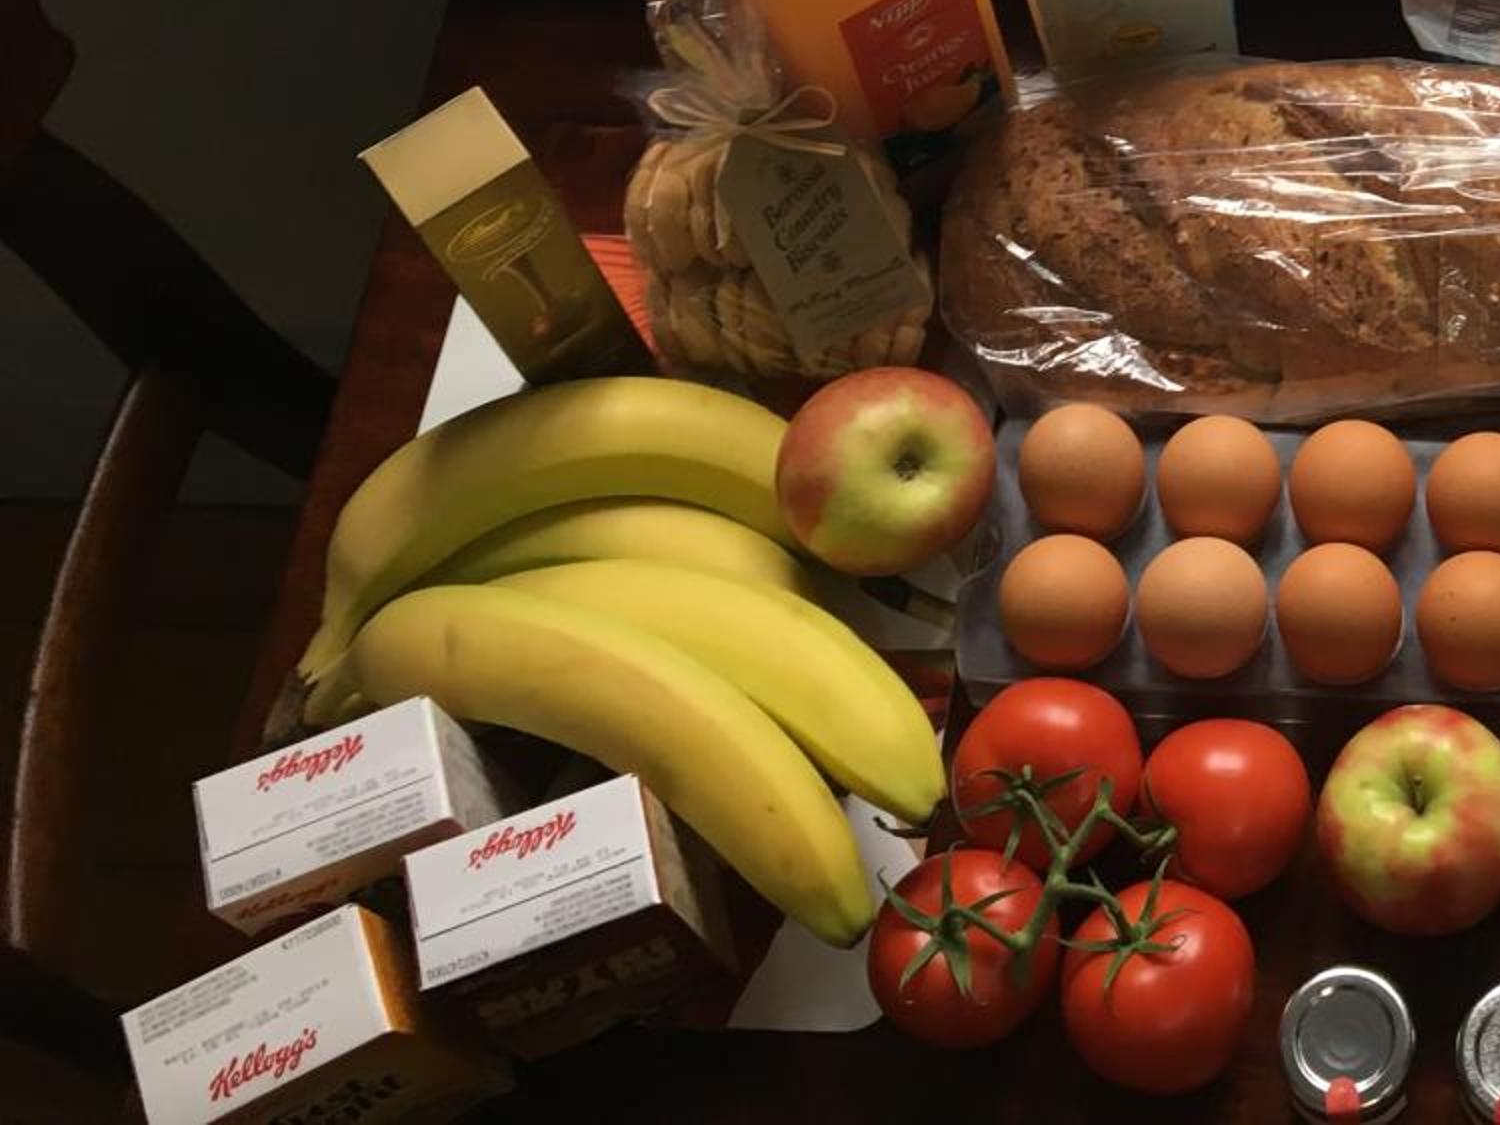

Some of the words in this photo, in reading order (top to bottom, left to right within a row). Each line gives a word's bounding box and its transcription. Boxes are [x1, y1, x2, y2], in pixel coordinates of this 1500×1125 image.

[256, 733, 364, 793] Kellogg's
[467, 811, 577, 870] Kellogg's
[209, 1027, 318, 1102] Kellogg's
